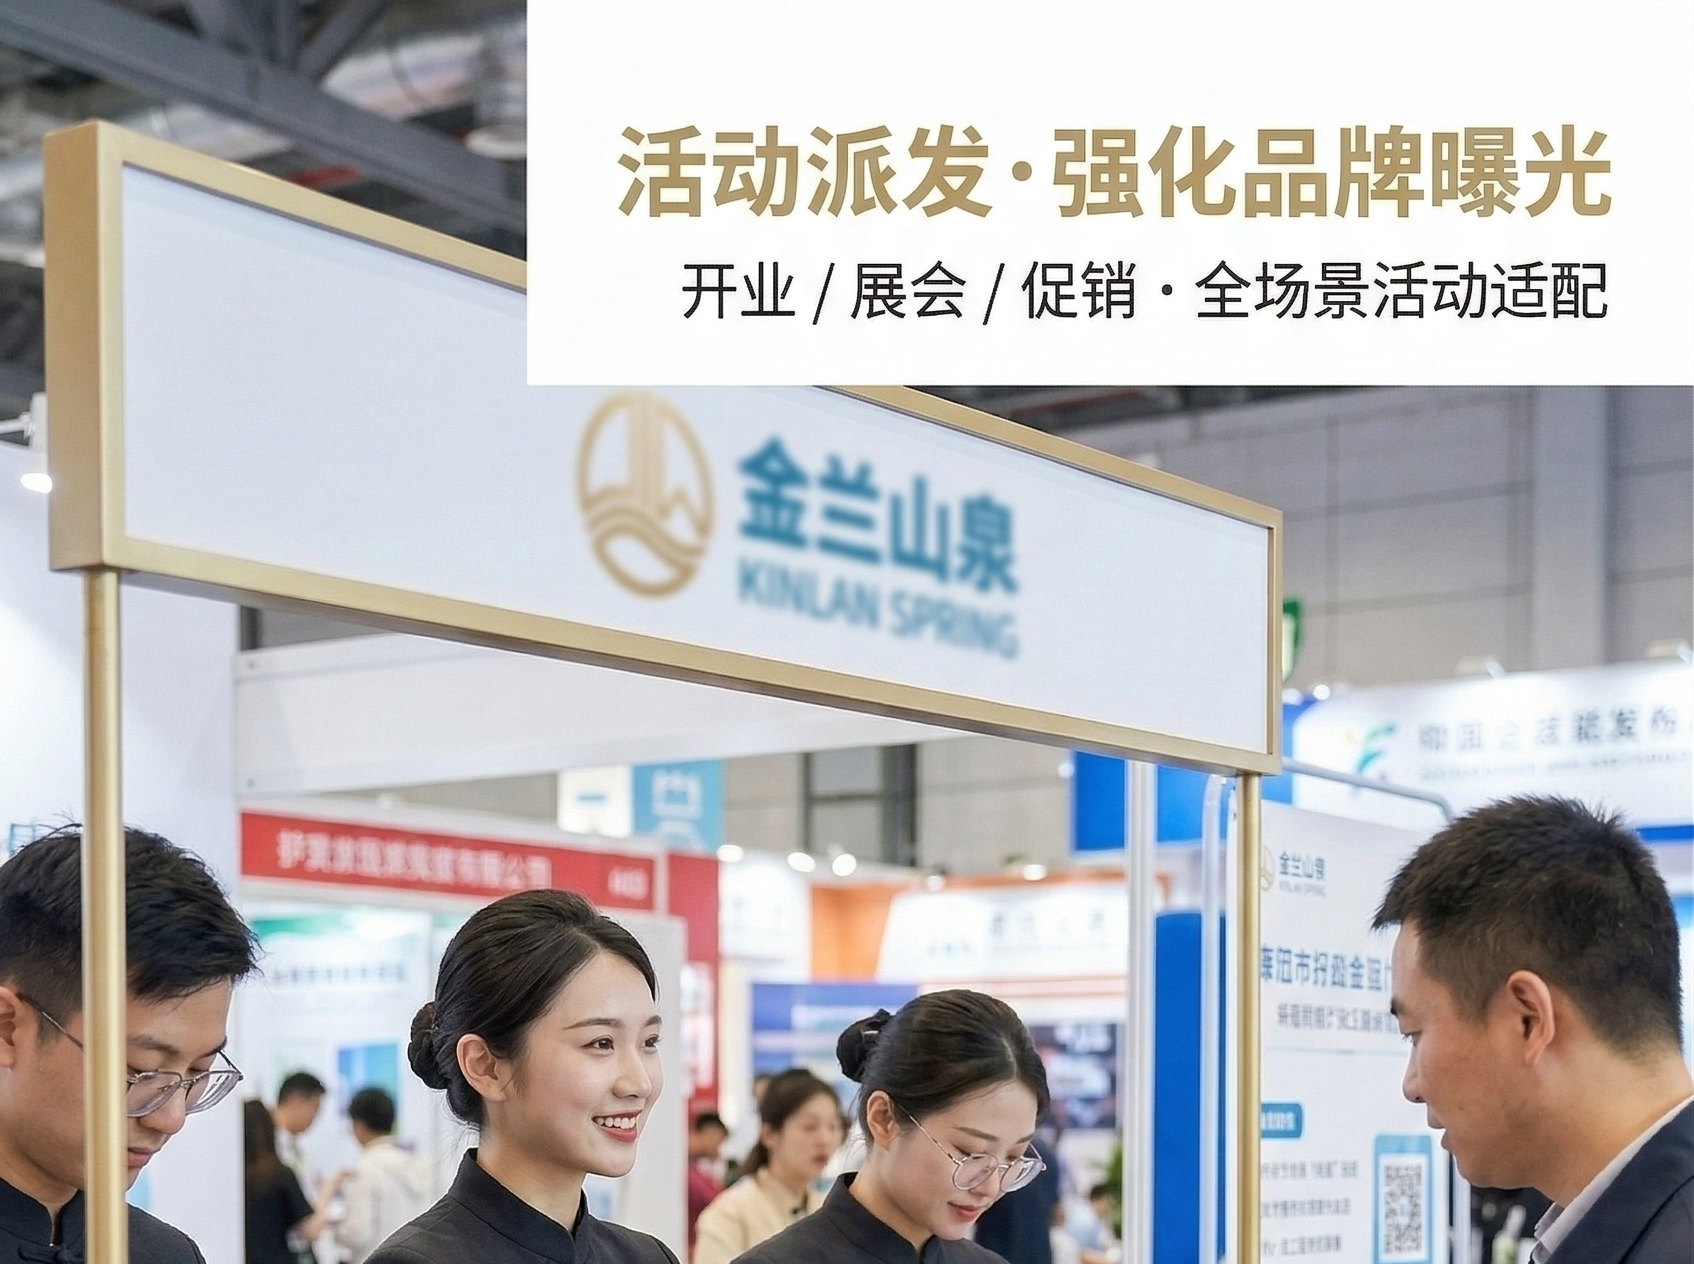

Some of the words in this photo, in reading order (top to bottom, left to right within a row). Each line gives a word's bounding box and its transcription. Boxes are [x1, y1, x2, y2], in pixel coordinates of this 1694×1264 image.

[736, 435, 1019, 595] 金兰山泉
[738, 556, 881, 629] KINLAN
[890, 590, 1021, 661] SPRING
